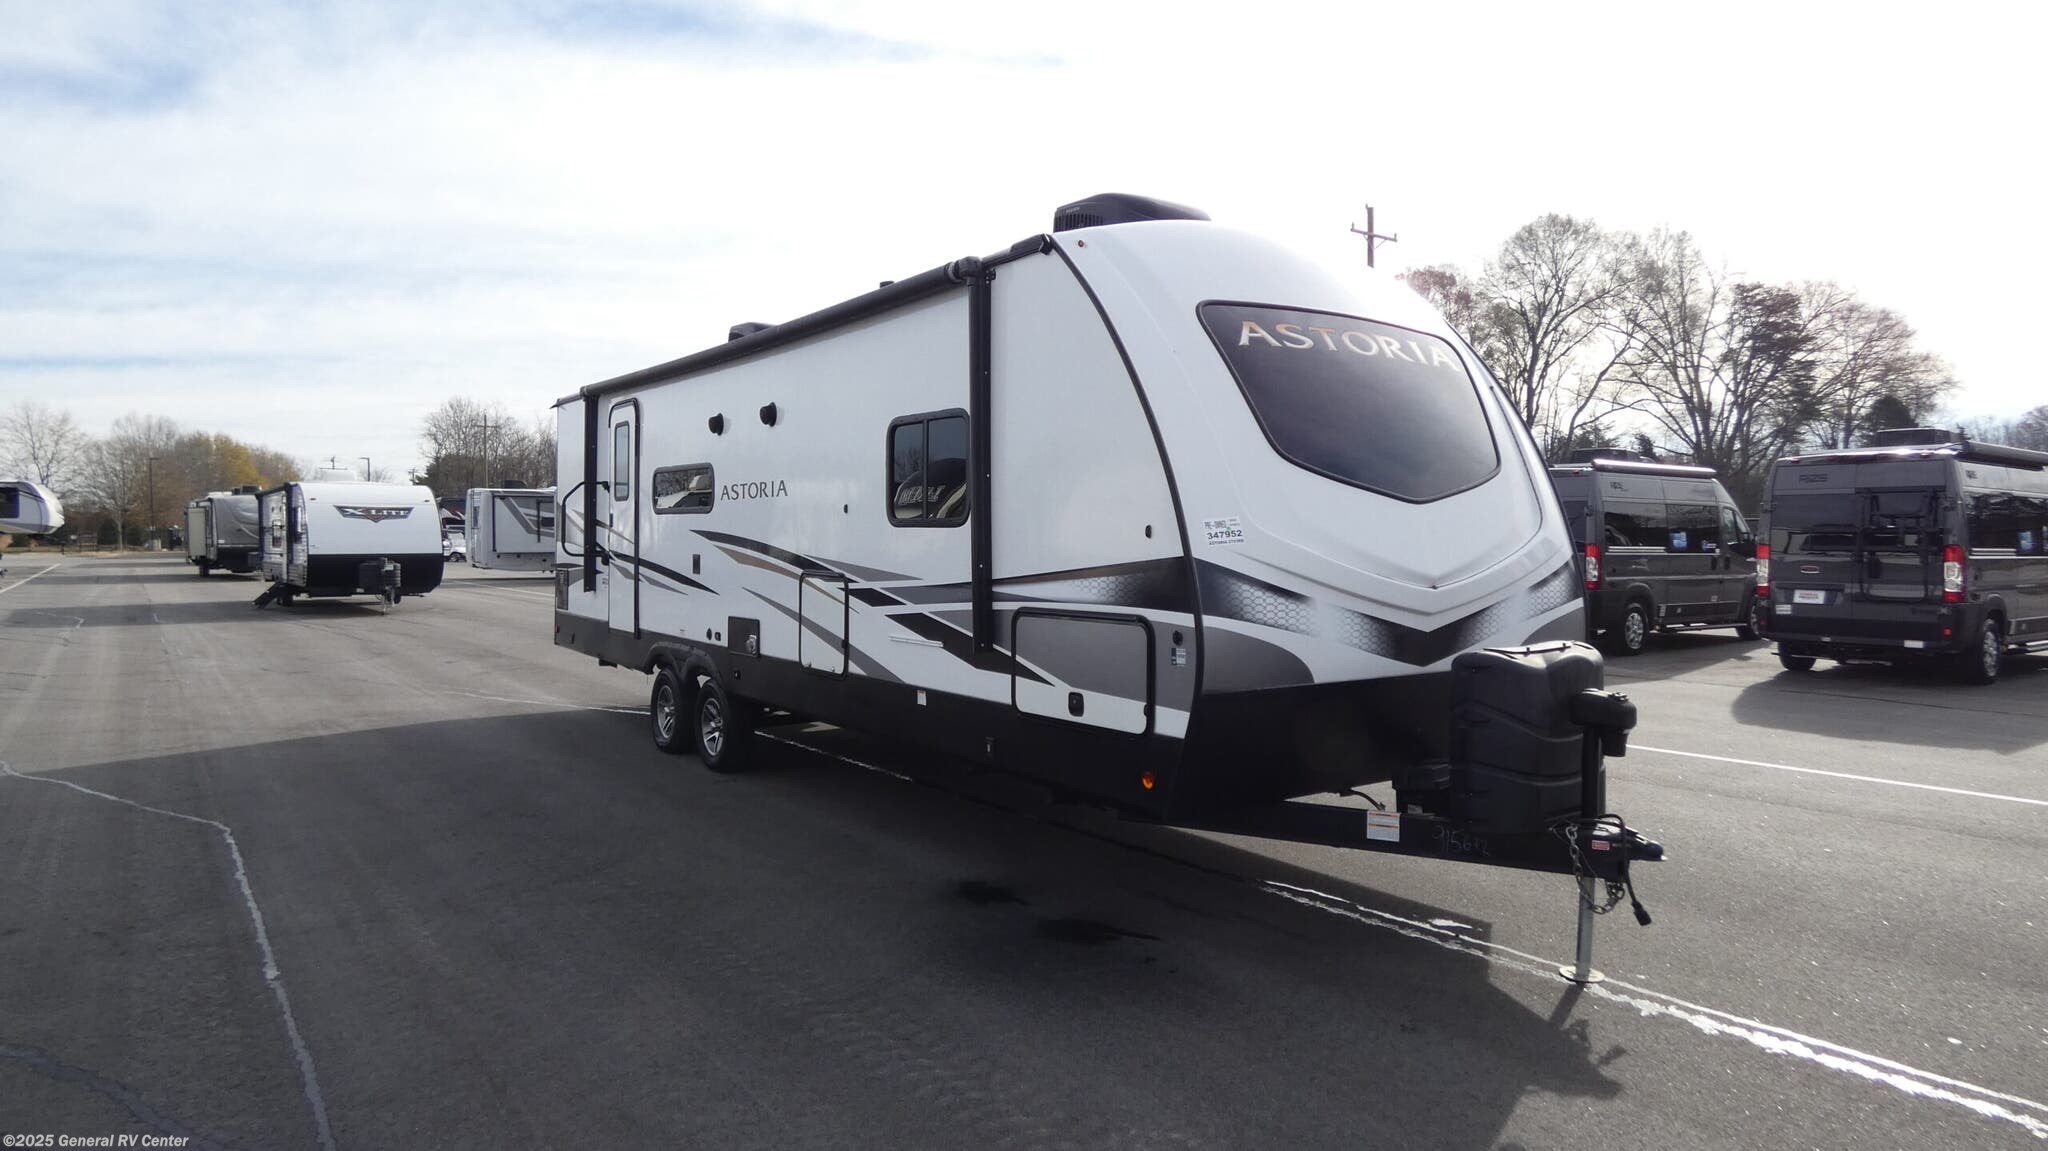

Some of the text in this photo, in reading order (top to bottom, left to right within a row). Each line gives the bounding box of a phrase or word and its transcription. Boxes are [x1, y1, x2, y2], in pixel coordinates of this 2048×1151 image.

[1238, 320, 1462, 372] ASTORIA
[720, 480, 788, 501] ASTORIA
[1207, 530, 1243, 540] 347952
